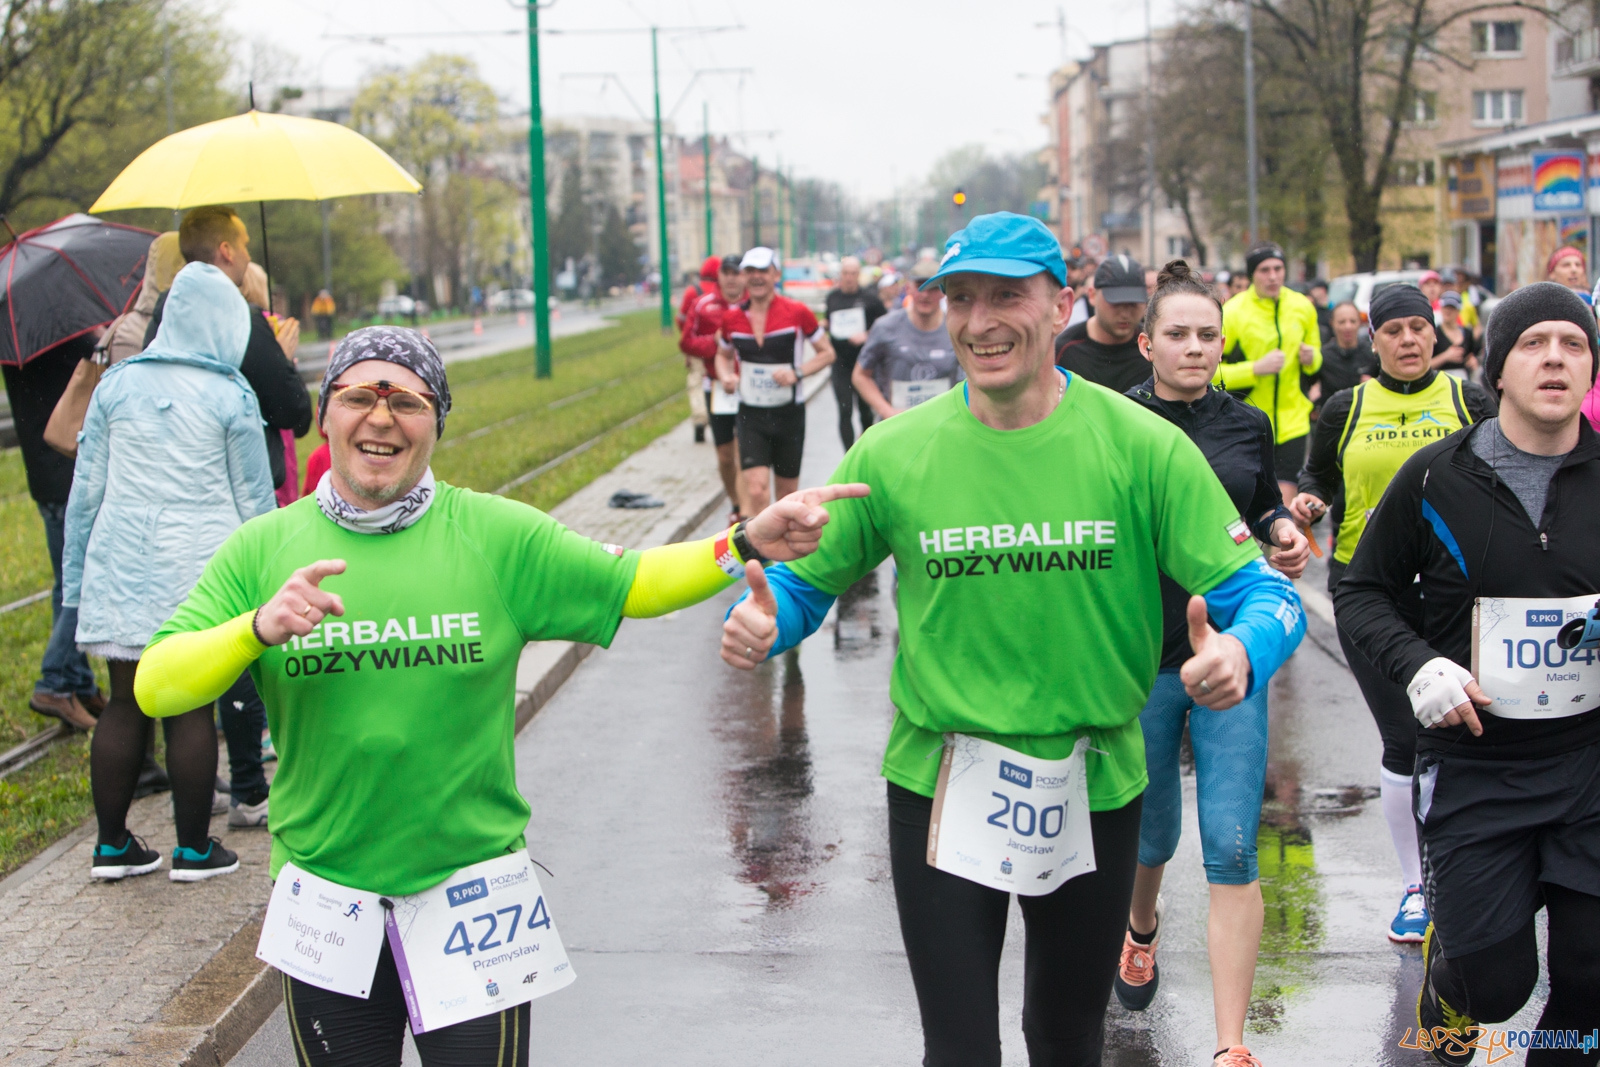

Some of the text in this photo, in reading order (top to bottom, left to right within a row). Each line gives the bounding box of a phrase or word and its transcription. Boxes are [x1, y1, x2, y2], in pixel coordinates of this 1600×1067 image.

[919, 520, 1116, 554] HERBALIFE
[926, 549, 1114, 579] ODŻYWIANIE
[285, 641, 484, 677] ODŻYWIANIE
[1503, 638, 1600, 669] 1004
[1546, 672, 1580, 682] Maciej
[987, 791, 1069, 839] 2001
[1006, 838, 1055, 855] Jarosław
[287, 913, 345, 947] biegnę dla
[443, 895, 551, 956] 4274
[294, 939, 322, 964] Kuby
[473, 943, 540, 971] Przemysław
